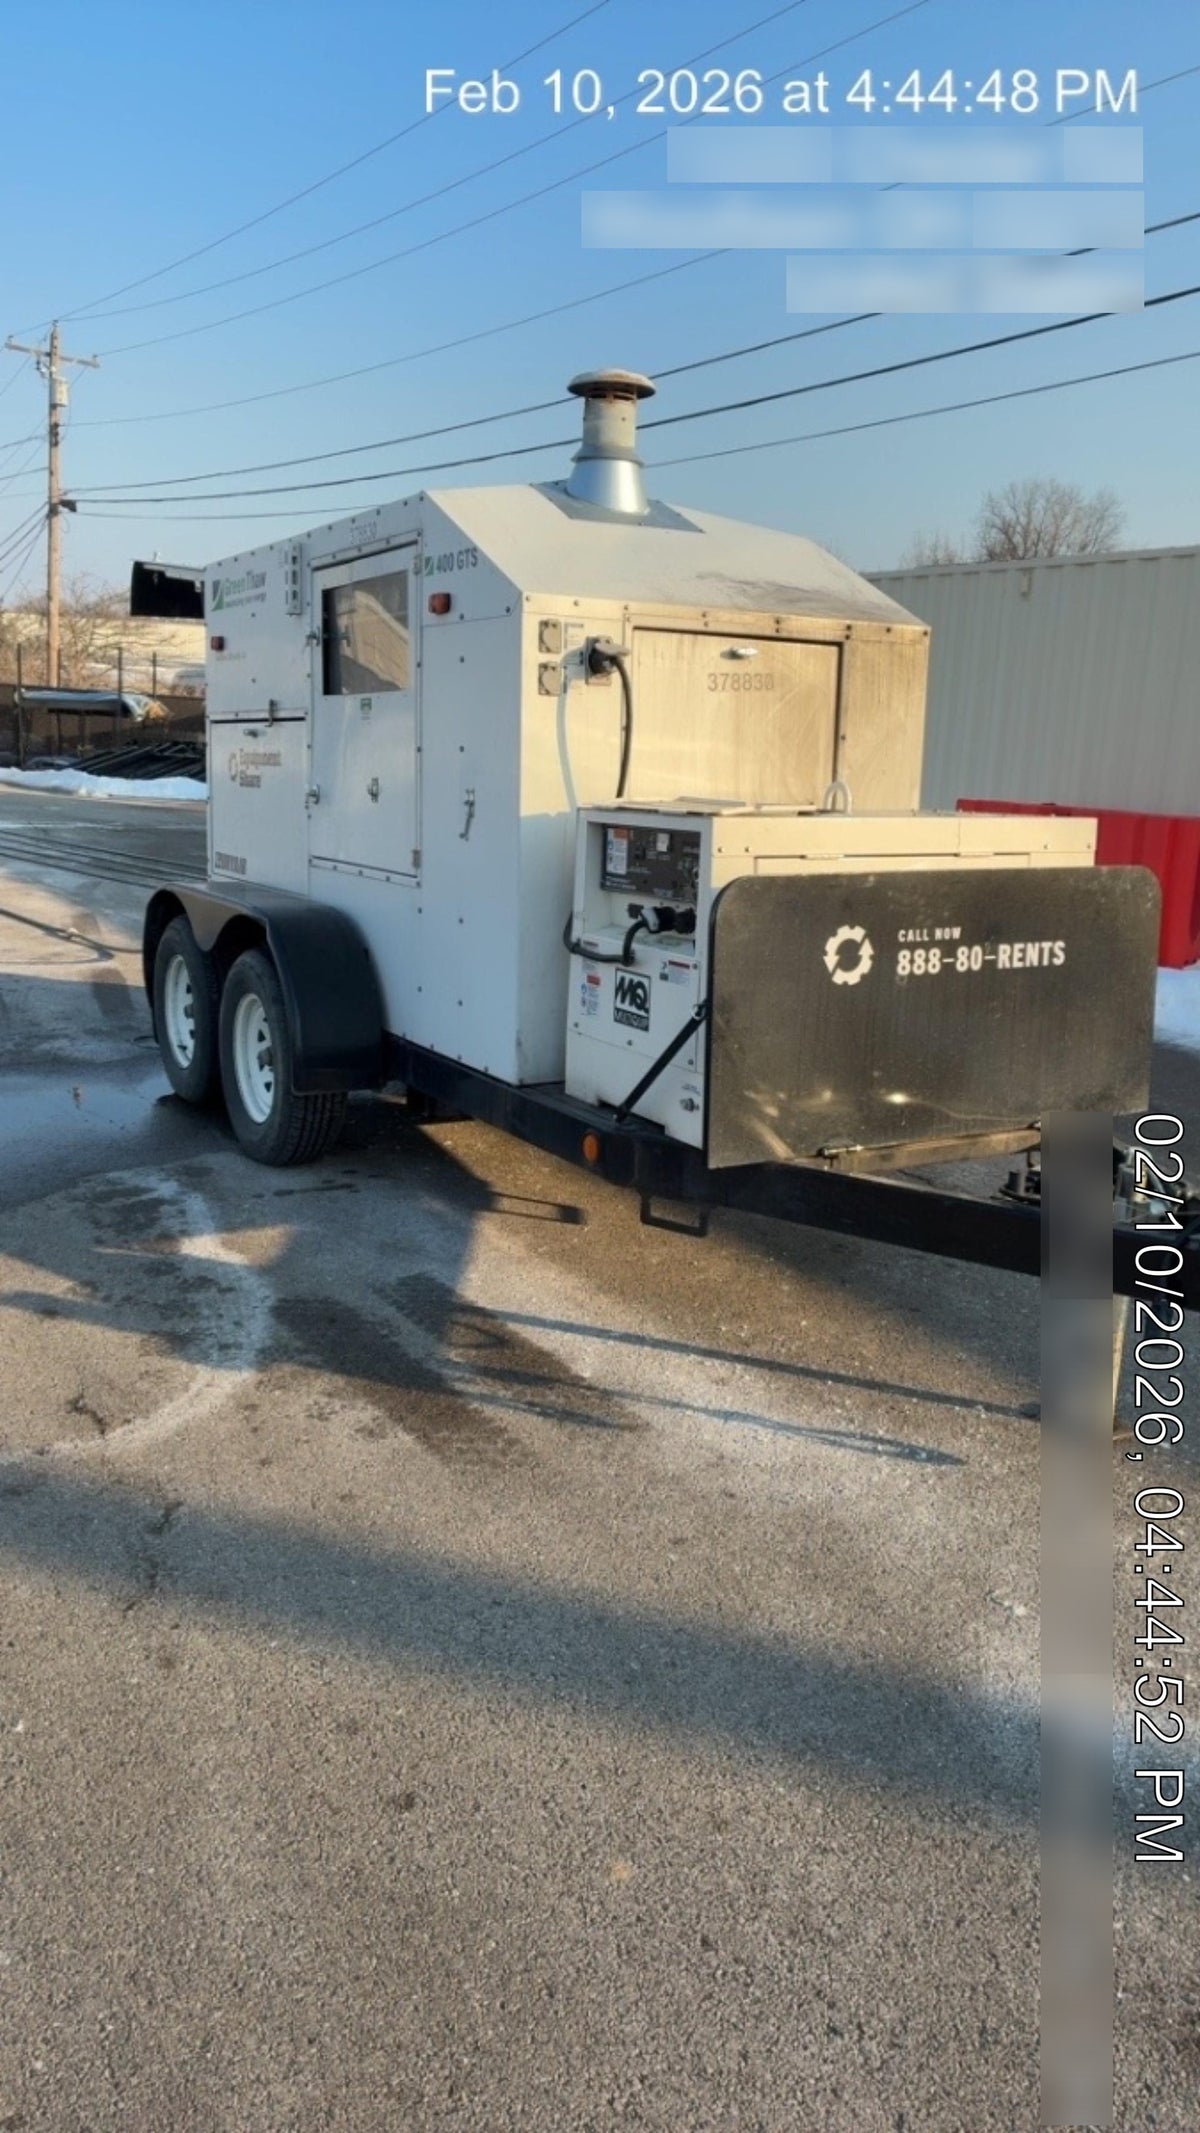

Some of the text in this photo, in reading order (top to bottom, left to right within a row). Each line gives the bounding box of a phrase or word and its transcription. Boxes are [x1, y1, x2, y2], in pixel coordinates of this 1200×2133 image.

[436, 547, 478, 573] 400 GTS
[707, 672, 774, 692] 378830
[898, 927, 961, 943] CALL NOW
[897, 941, 1065, 976] 888-80-RENTS
